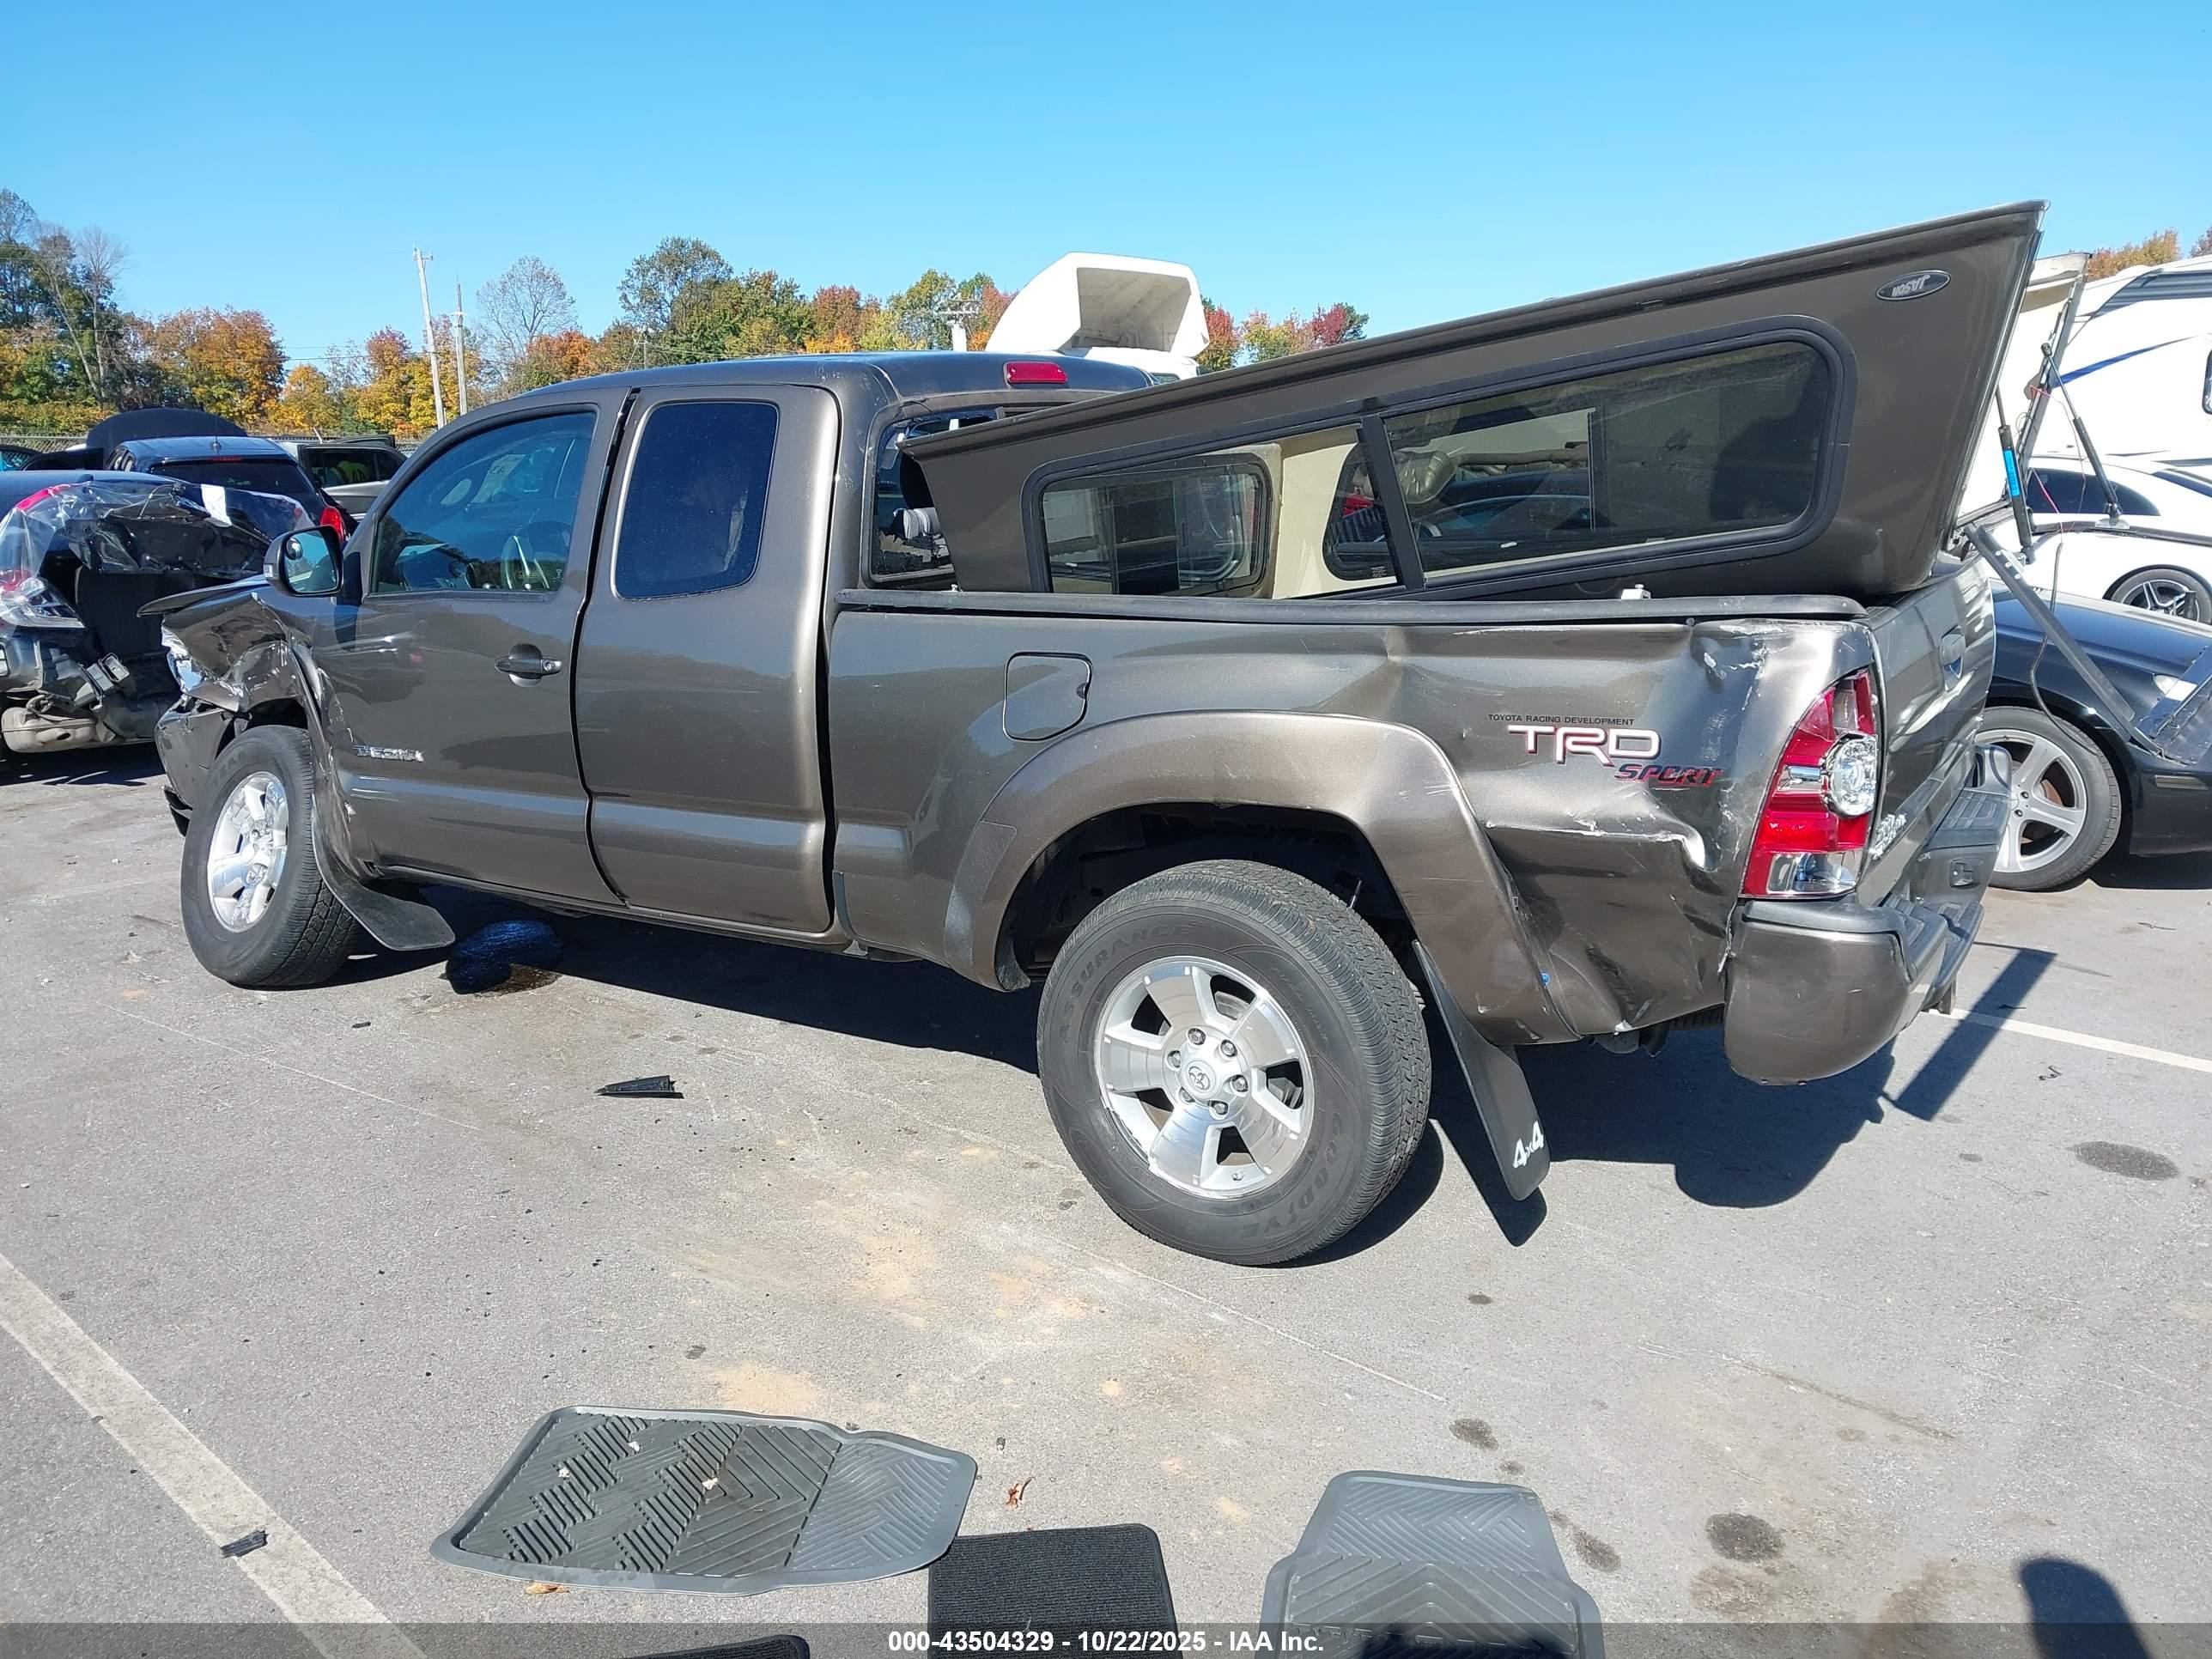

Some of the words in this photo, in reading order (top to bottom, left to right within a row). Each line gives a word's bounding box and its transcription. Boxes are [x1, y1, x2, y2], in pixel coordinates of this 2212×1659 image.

[1892, 274, 1931, 298] JASON
[1487, 714, 1522, 722] TOYOTA
[1525, 714, 1561, 724] RACING
[1564, 715, 1635, 726] DEVELOPMENT
[1507, 724, 1662, 768] TRD
[1614, 763, 1724, 787] SPORT
[1058, 924, 1190, 1044] ASSURANCE
[1219, 1112, 1343, 1242] GOODYE
